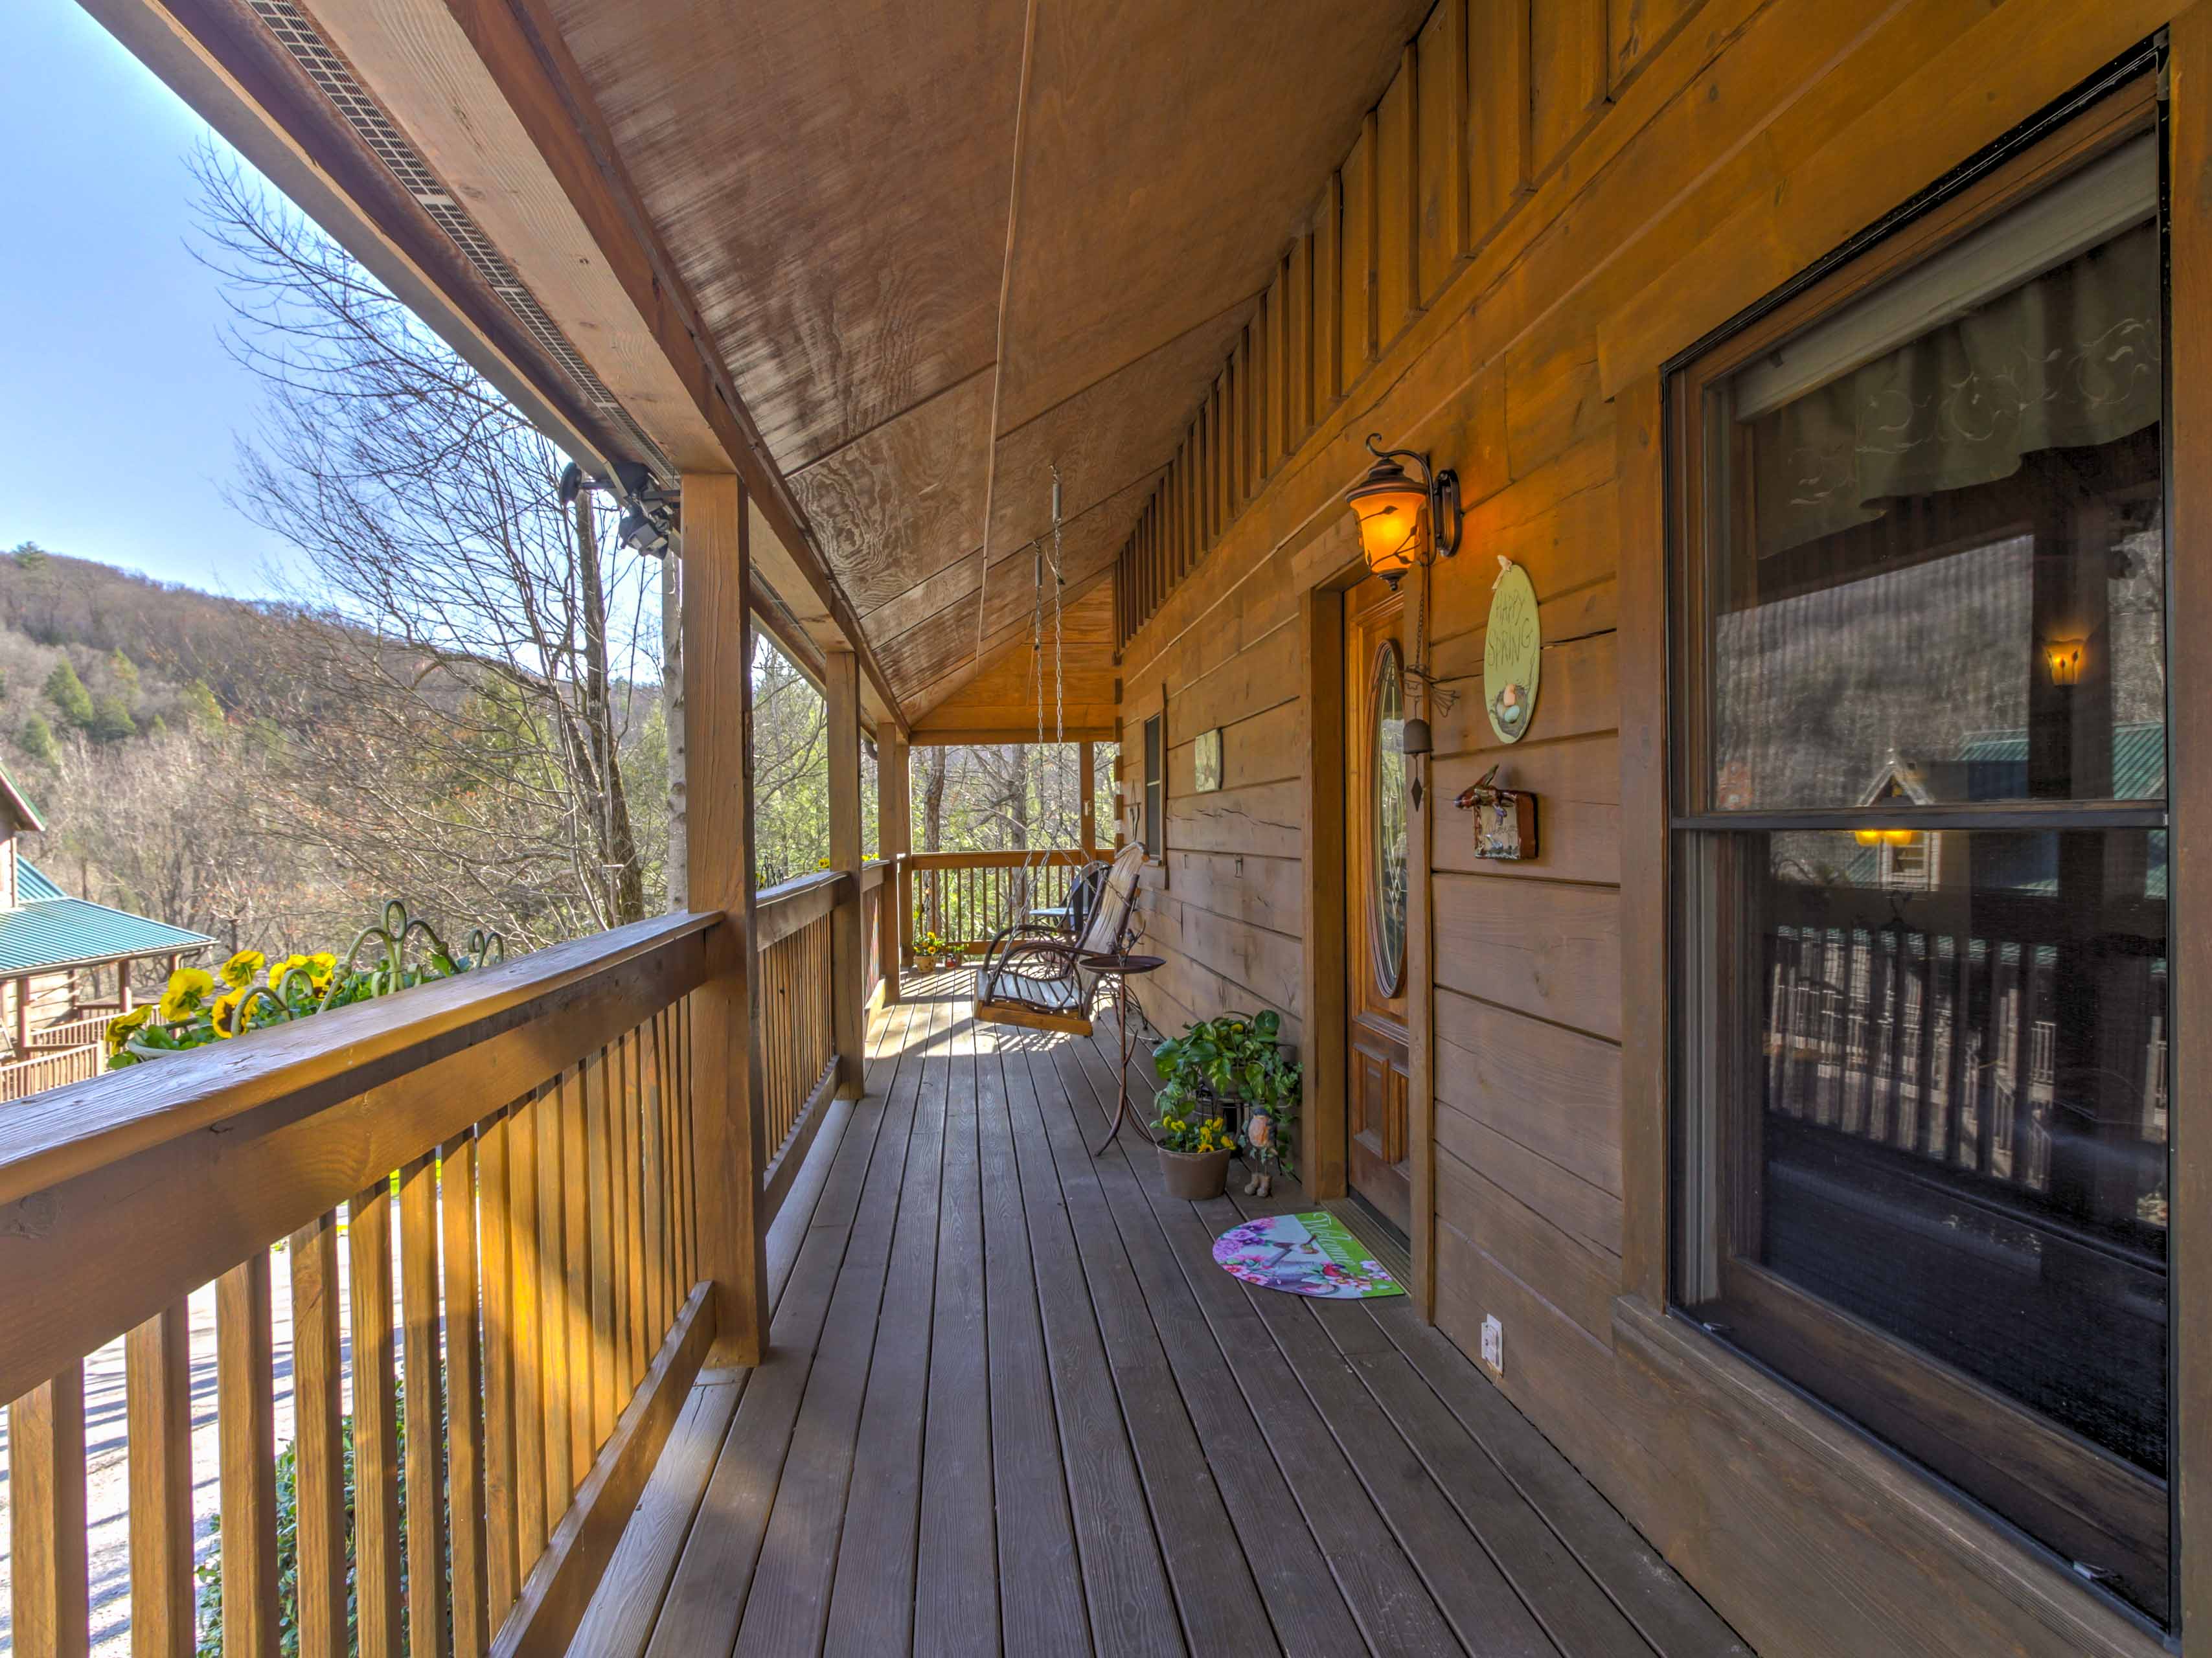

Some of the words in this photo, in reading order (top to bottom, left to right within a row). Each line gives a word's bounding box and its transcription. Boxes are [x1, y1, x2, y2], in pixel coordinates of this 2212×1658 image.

[1496, 586, 1527, 626] HAPPY
[1487, 617, 1533, 671] SPRING
[1300, 1212, 1356, 1266] Welcome
